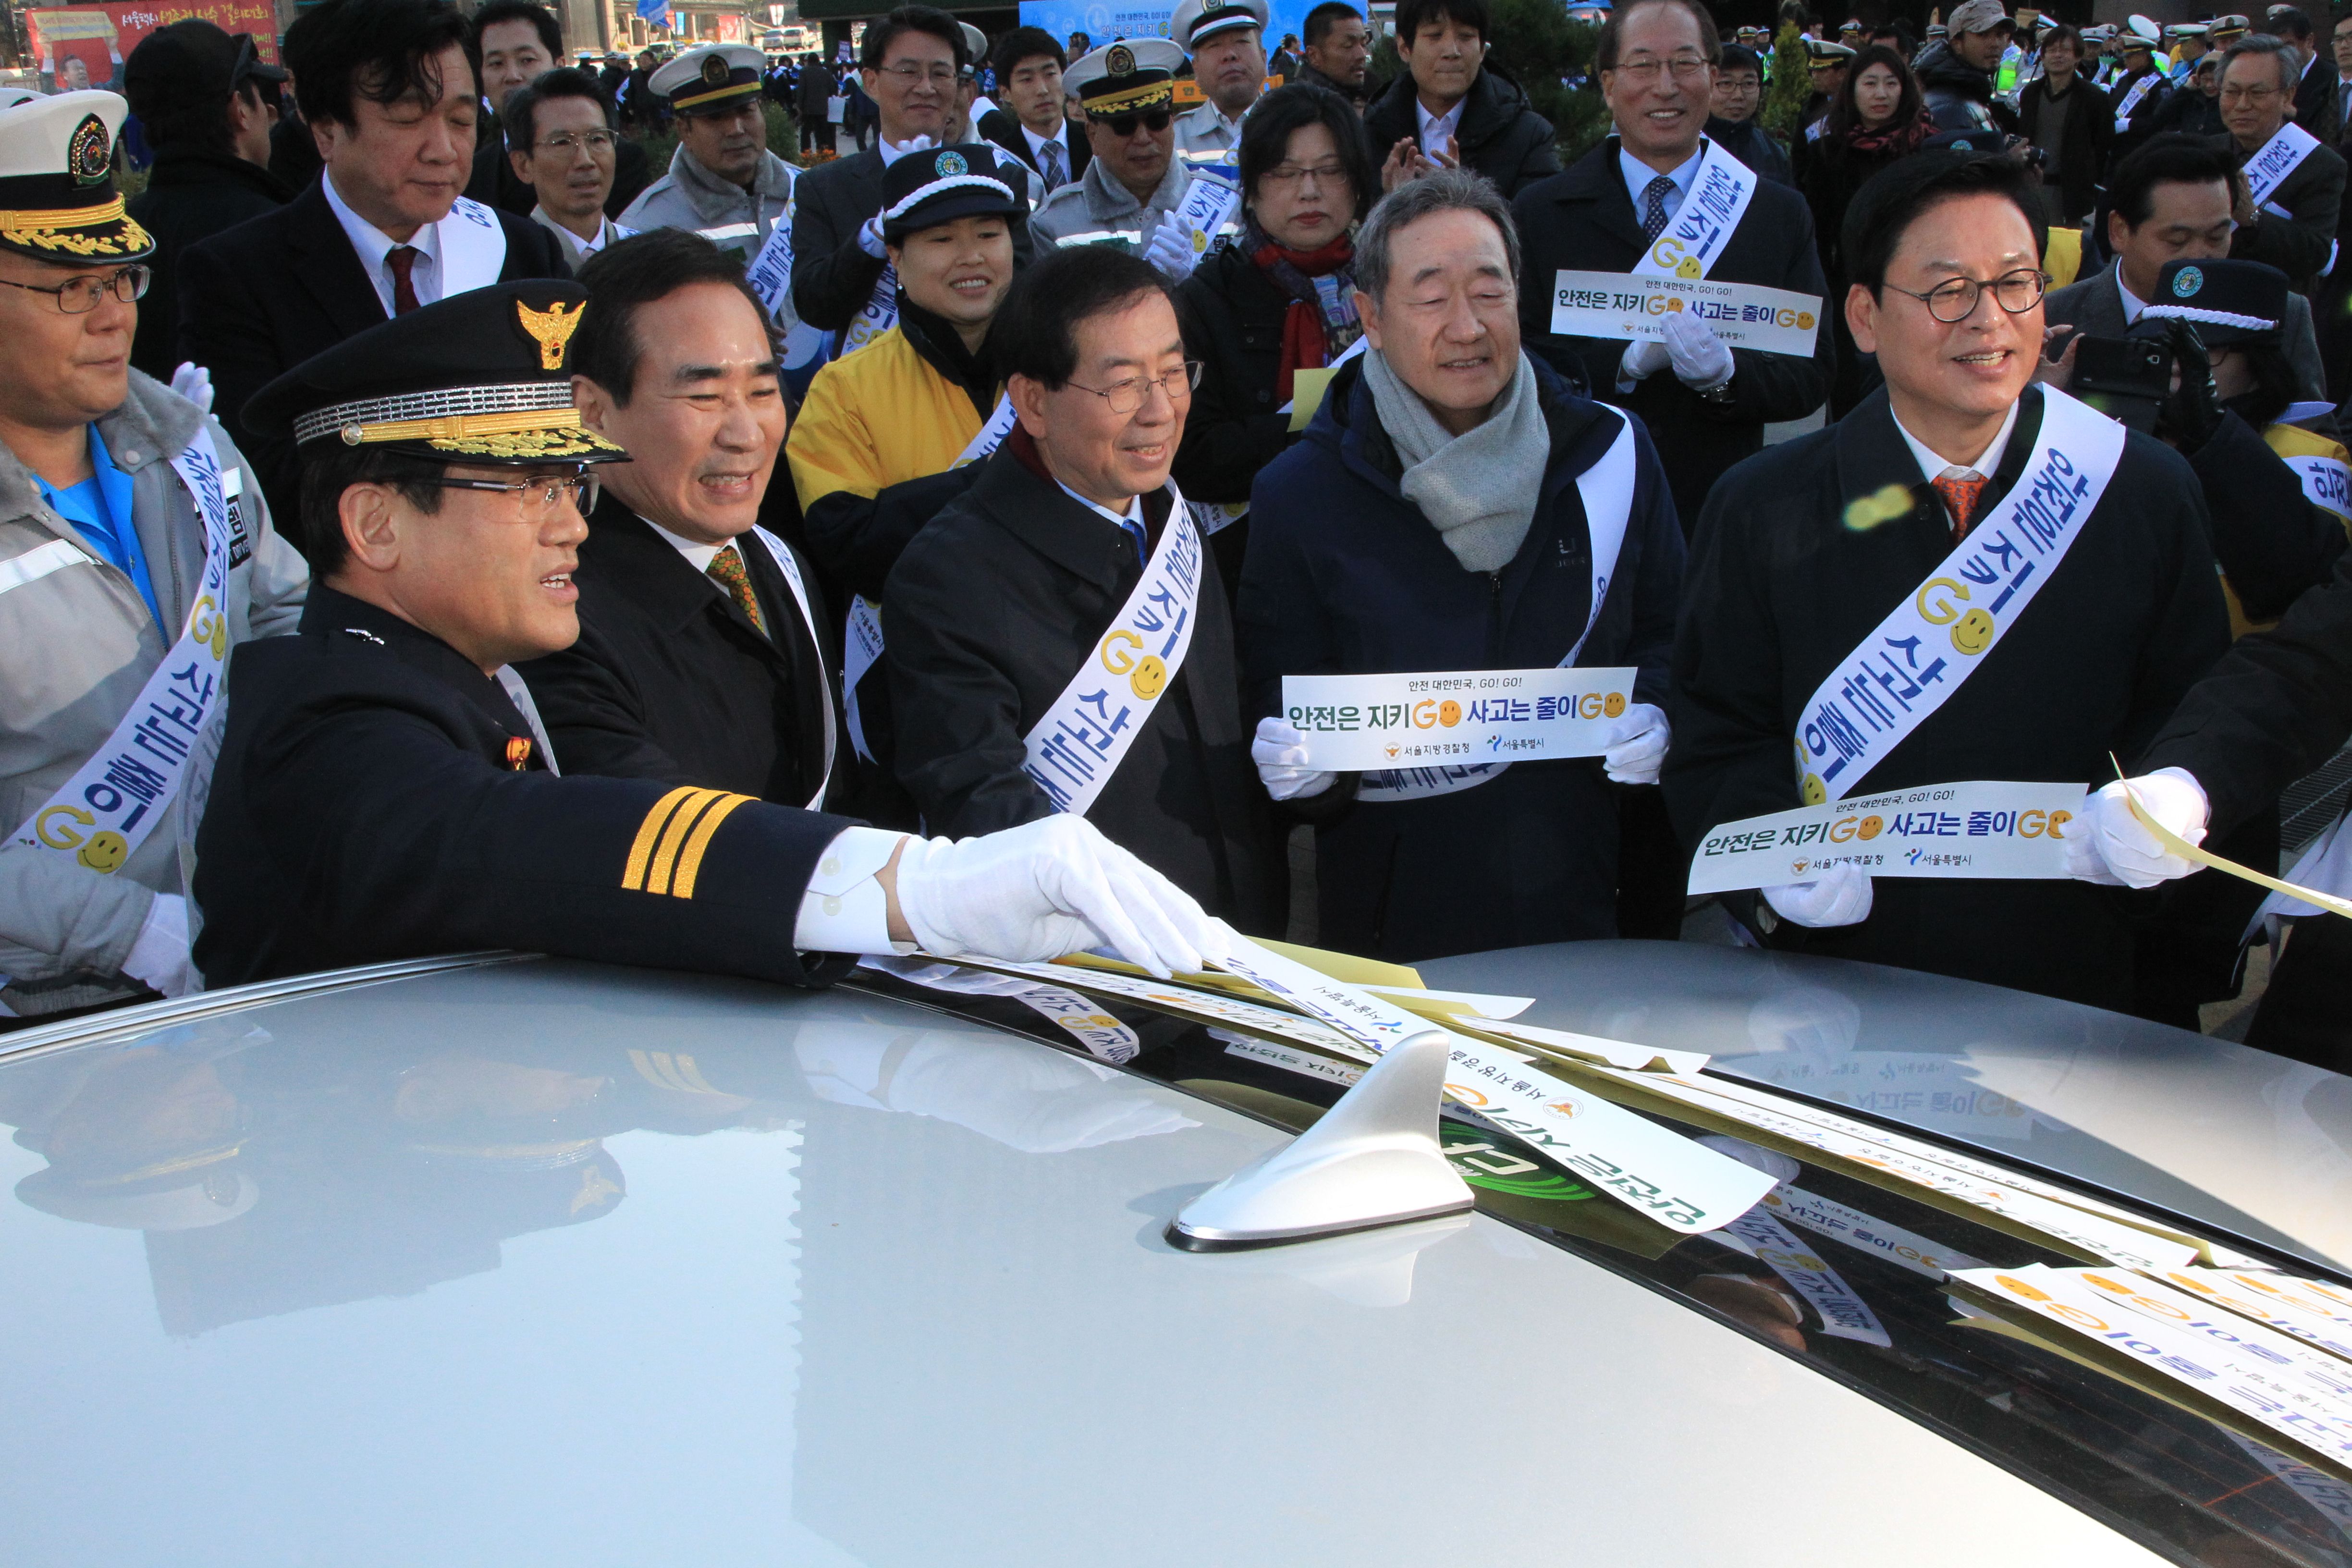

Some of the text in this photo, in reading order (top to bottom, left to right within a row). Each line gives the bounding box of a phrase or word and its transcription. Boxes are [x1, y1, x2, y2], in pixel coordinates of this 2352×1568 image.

[1137, 21, 1169, 37] 지키G
[1696, 164, 1745, 224] 안전은
[1558, 289, 1608, 310] 안전은
[1741, 303, 1815, 331] 줄이GO
[1645, 280, 1662, 290] 안전
[2011, 448, 2089, 555] 안전은
[1916, 529, 2036, 656] 지키GO
[1100, 579, 1188, 701] 지키GO
[1409, 676, 1523, 692] 안전 대한민국, GO! GO!
[1840, 635, 1948, 733] 사고는
[133, 661, 213, 767] 사고는
[1288, 691, 1627, 731] 안전은 지키GO 사고는 줄이GO
[1040, 688, 1131, 787] 사고는
[1404, 737, 1545, 757] 서울지방경찰청 서울특별시
[1836, 790, 1955, 813] 안전 대한민국, GO! GO!
[1704, 829, 1777, 857] 안전은
[1779, 815, 1884, 846] 지키GO
[1887, 811, 1961, 837] 사고는
[1922, 854, 1972, 866] 서울특별시
[1446, 1049, 1546, 1101] 서울지방경찰
[1443, 1082, 1571, 1150] 지키G
[1564, 1153, 1707, 1226] 안전은
